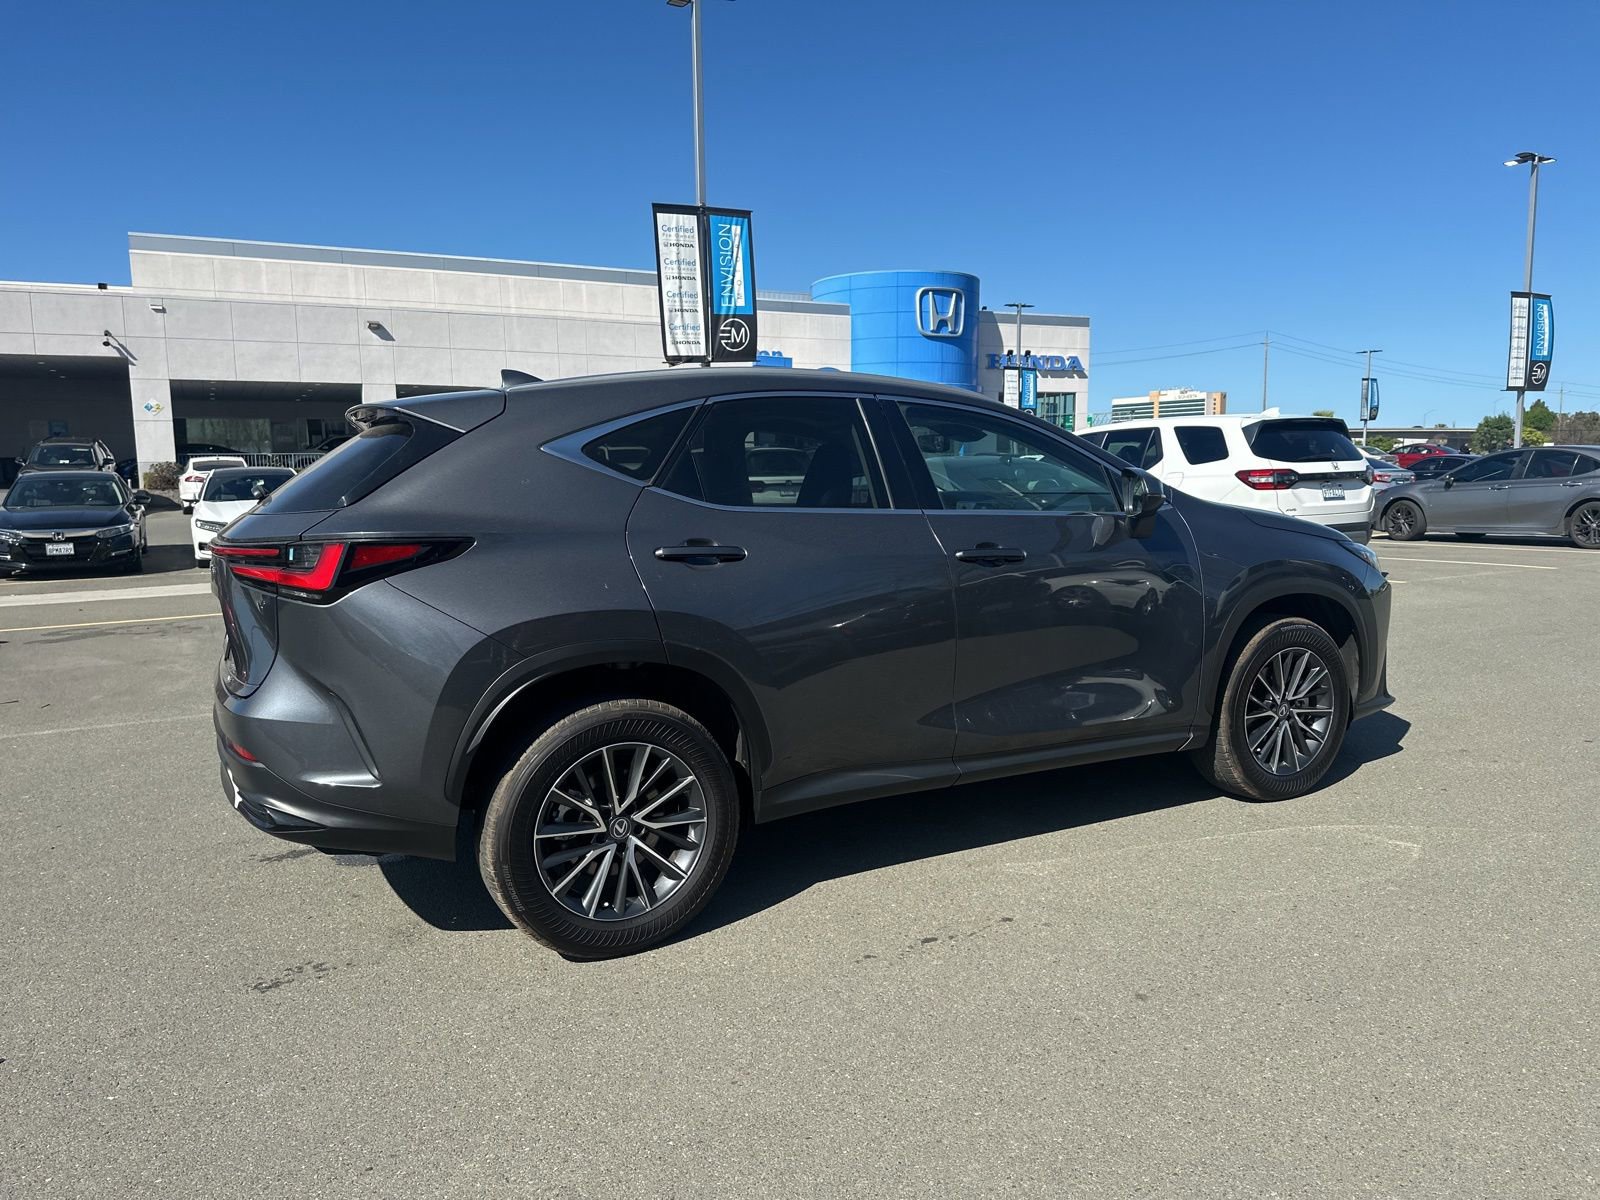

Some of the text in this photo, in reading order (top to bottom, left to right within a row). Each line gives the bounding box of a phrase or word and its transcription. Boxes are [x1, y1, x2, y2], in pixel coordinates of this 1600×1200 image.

[661, 225, 695, 234] Certified
[663, 258, 697, 267] Certified
[718, 223, 736, 307] ENVISION
[666, 290, 699, 299] Certified
[669, 322, 701, 331] Certified
[1536, 303, 1545, 356] ENVISION
